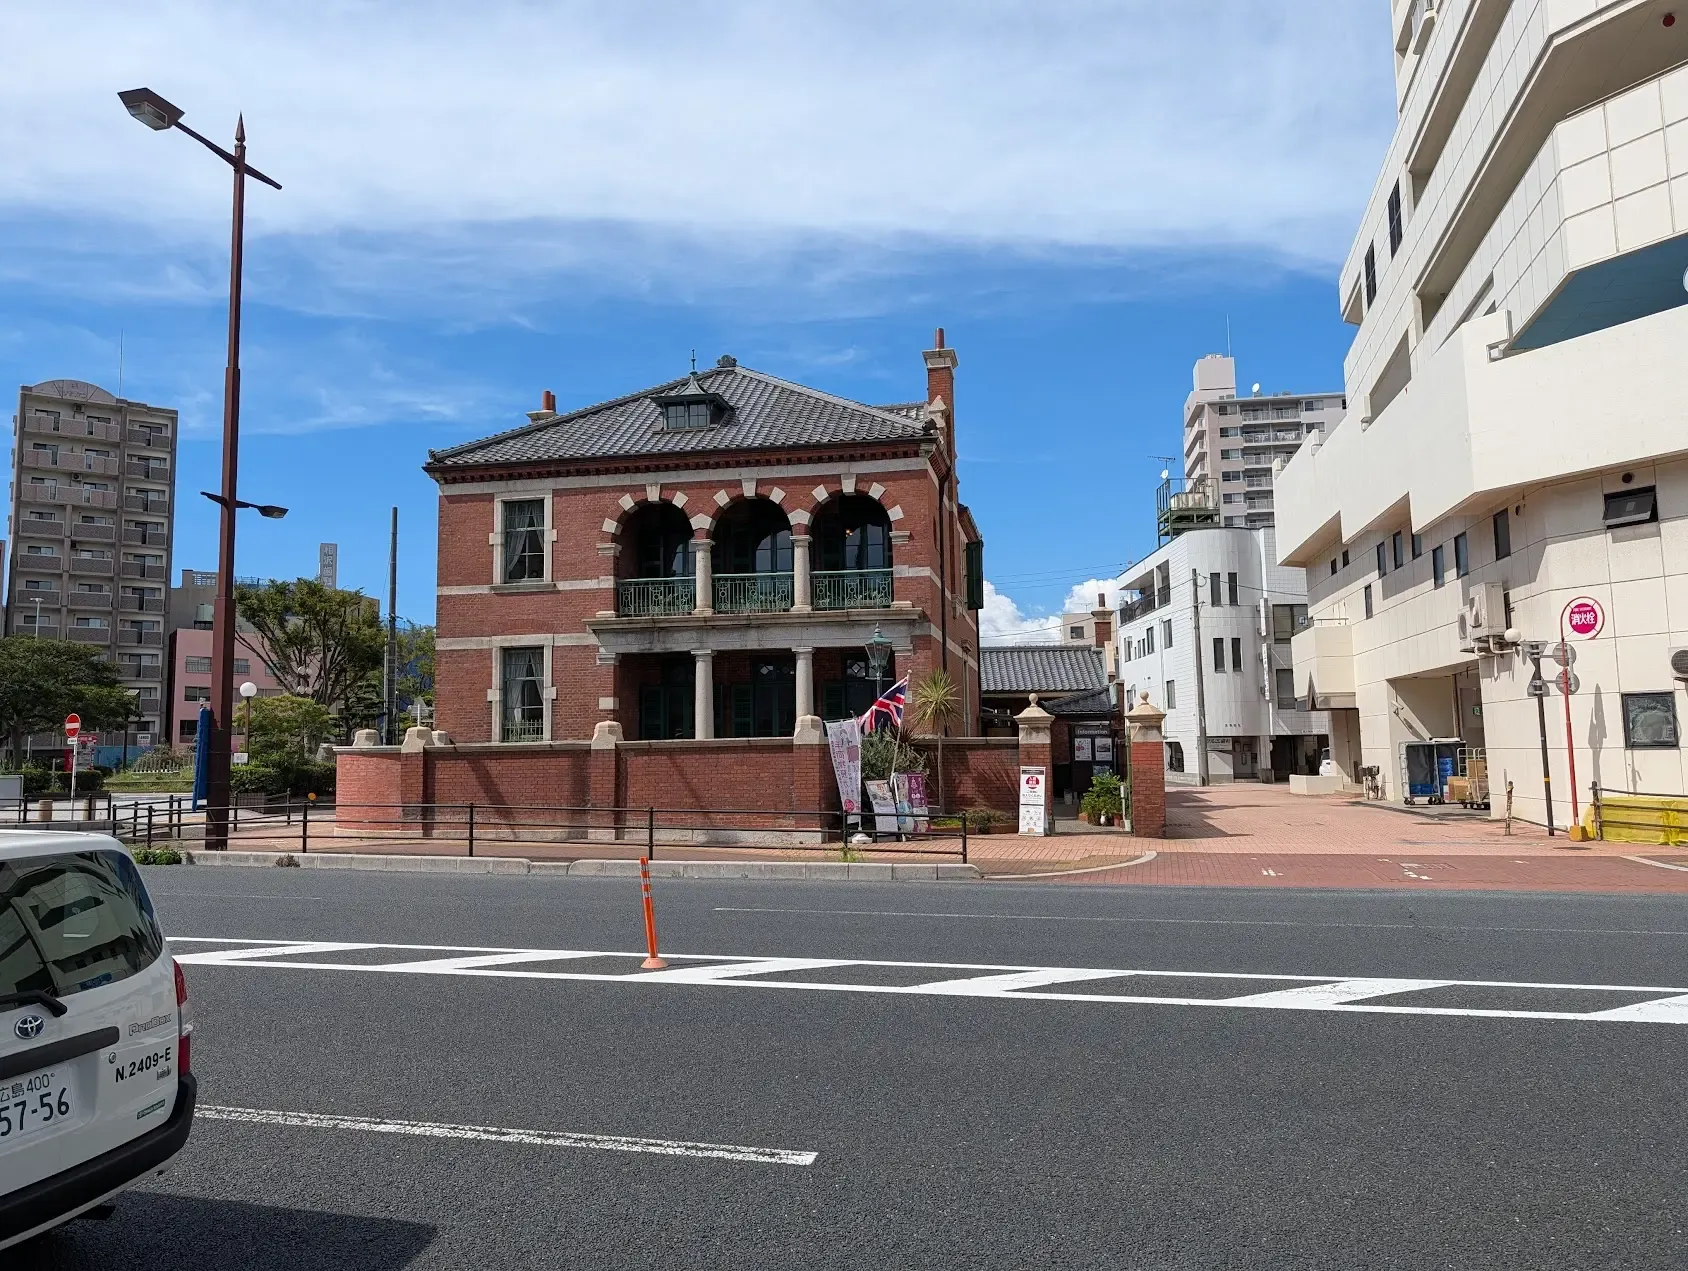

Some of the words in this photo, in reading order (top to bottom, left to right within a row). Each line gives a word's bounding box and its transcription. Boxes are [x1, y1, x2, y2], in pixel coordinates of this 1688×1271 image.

[1571, 612, 1596, 625] 消火栓
[115, 1046, 172, 1083] N.2409-E
[0, 1082, 25, 1101] 広島
[26, 1077, 50, 1093] 400
[0, 1087, 70, 1137] 57-56
